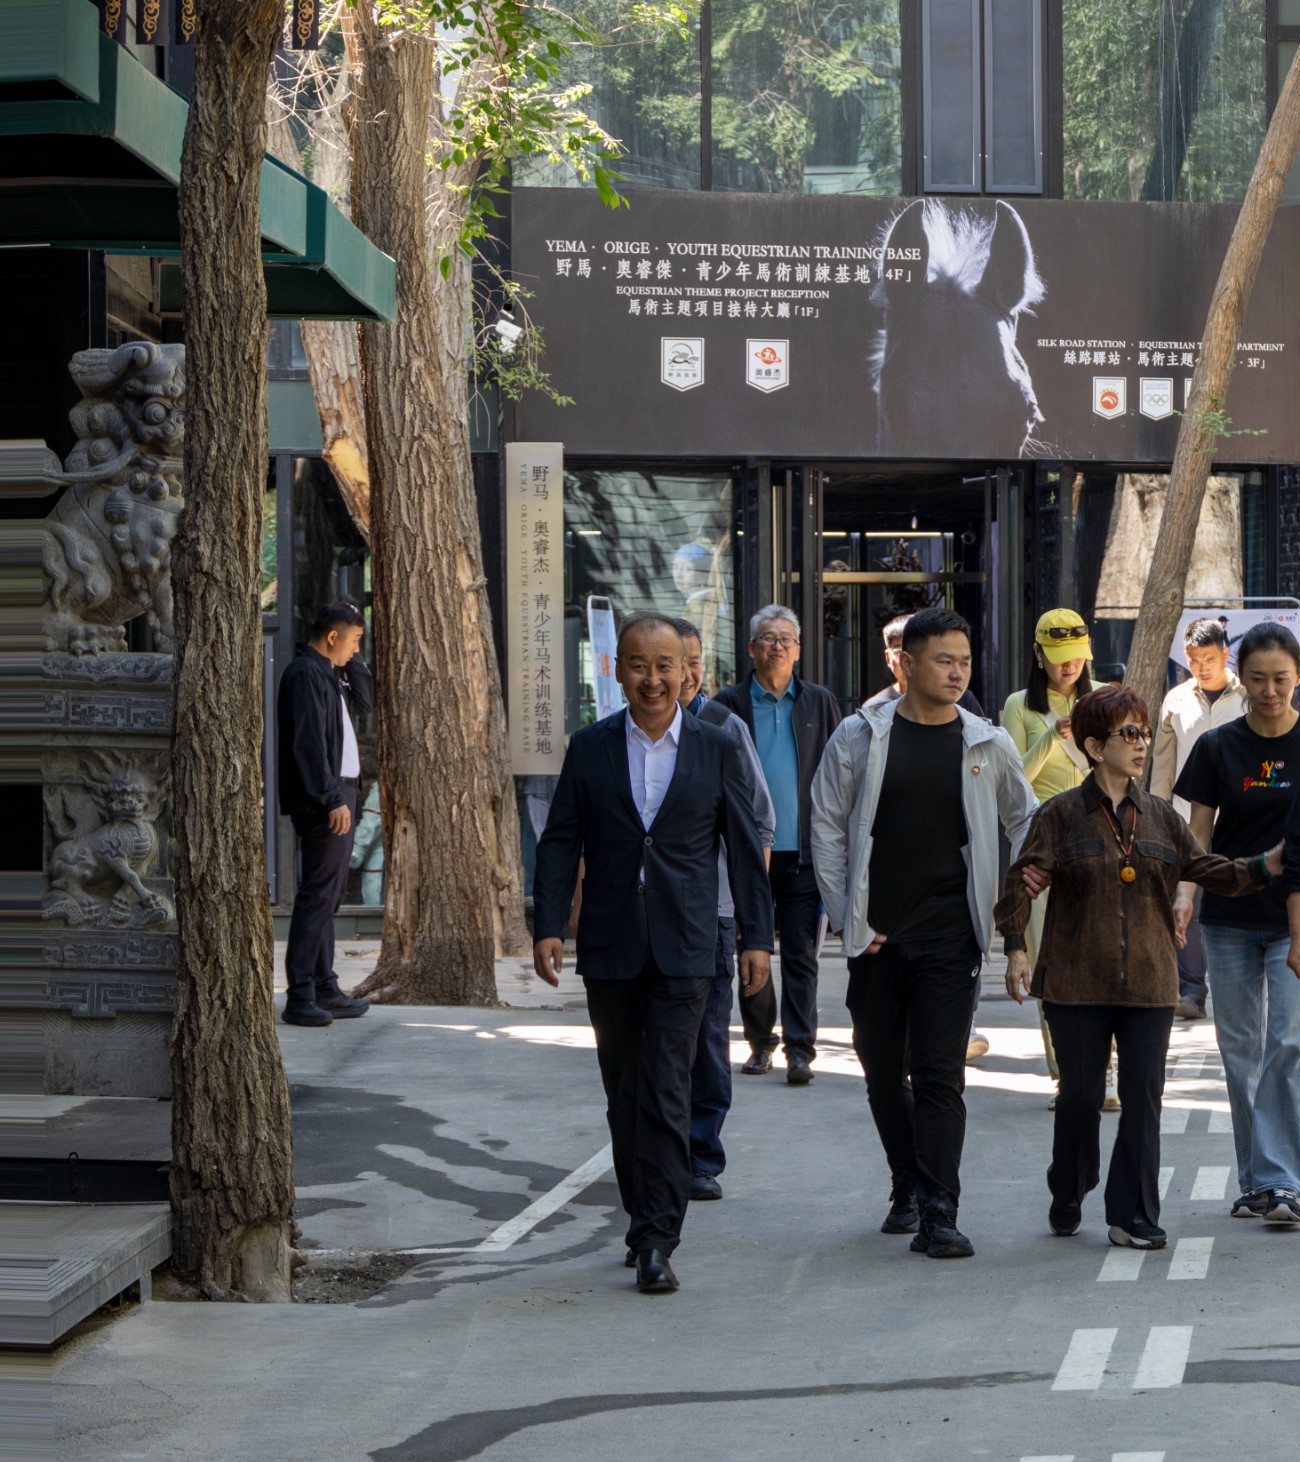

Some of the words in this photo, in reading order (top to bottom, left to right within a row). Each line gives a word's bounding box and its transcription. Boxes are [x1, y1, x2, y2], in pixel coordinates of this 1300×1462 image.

[545, 240, 587, 253] YEMA
[604, 241, 650, 254] ORIGE
[667, 242, 718, 256] YOUTH
[721, 244, 810, 259] EQUESTRIAN
[814, 246, 883, 260] TRAINING
[886, 248, 921, 260] BASE
[616, 286, 682, 296] EQUESTRIAN
[685, 287, 722, 297] THEME
[724, 288, 769, 299] PROJECT
[770, 289, 830, 299] RECEPTION
[1037, 339, 1057, 347] SILK
[1059, 339, 1085, 348] ROAD
[1087, 340, 1126, 348] STATION
[1139, 341, 1195, 350] EQUESTRIAN
[1236, 343, 1285, 351] PARTMENT
